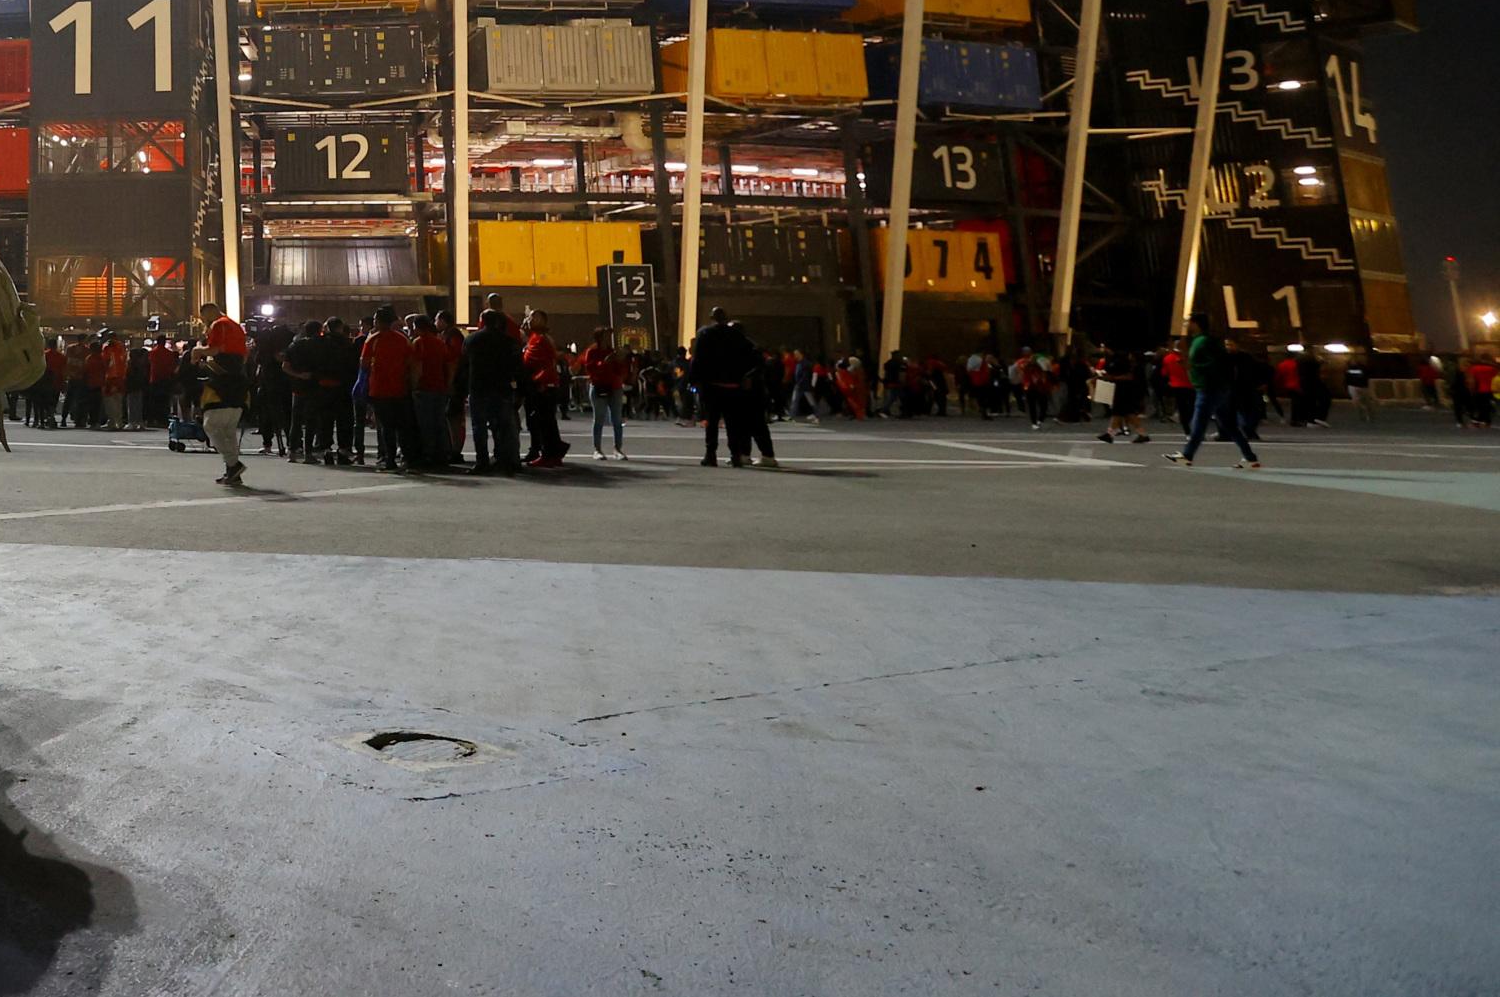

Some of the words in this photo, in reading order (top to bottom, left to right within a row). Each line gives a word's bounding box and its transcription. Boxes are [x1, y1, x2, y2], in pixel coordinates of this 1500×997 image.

[1325, 54, 1378, 143] 14
[315, 133, 371, 179] 12
[932, 145, 977, 190] 13
[616, 276, 646, 296] 12
[1222, 285, 1301, 329] L1
